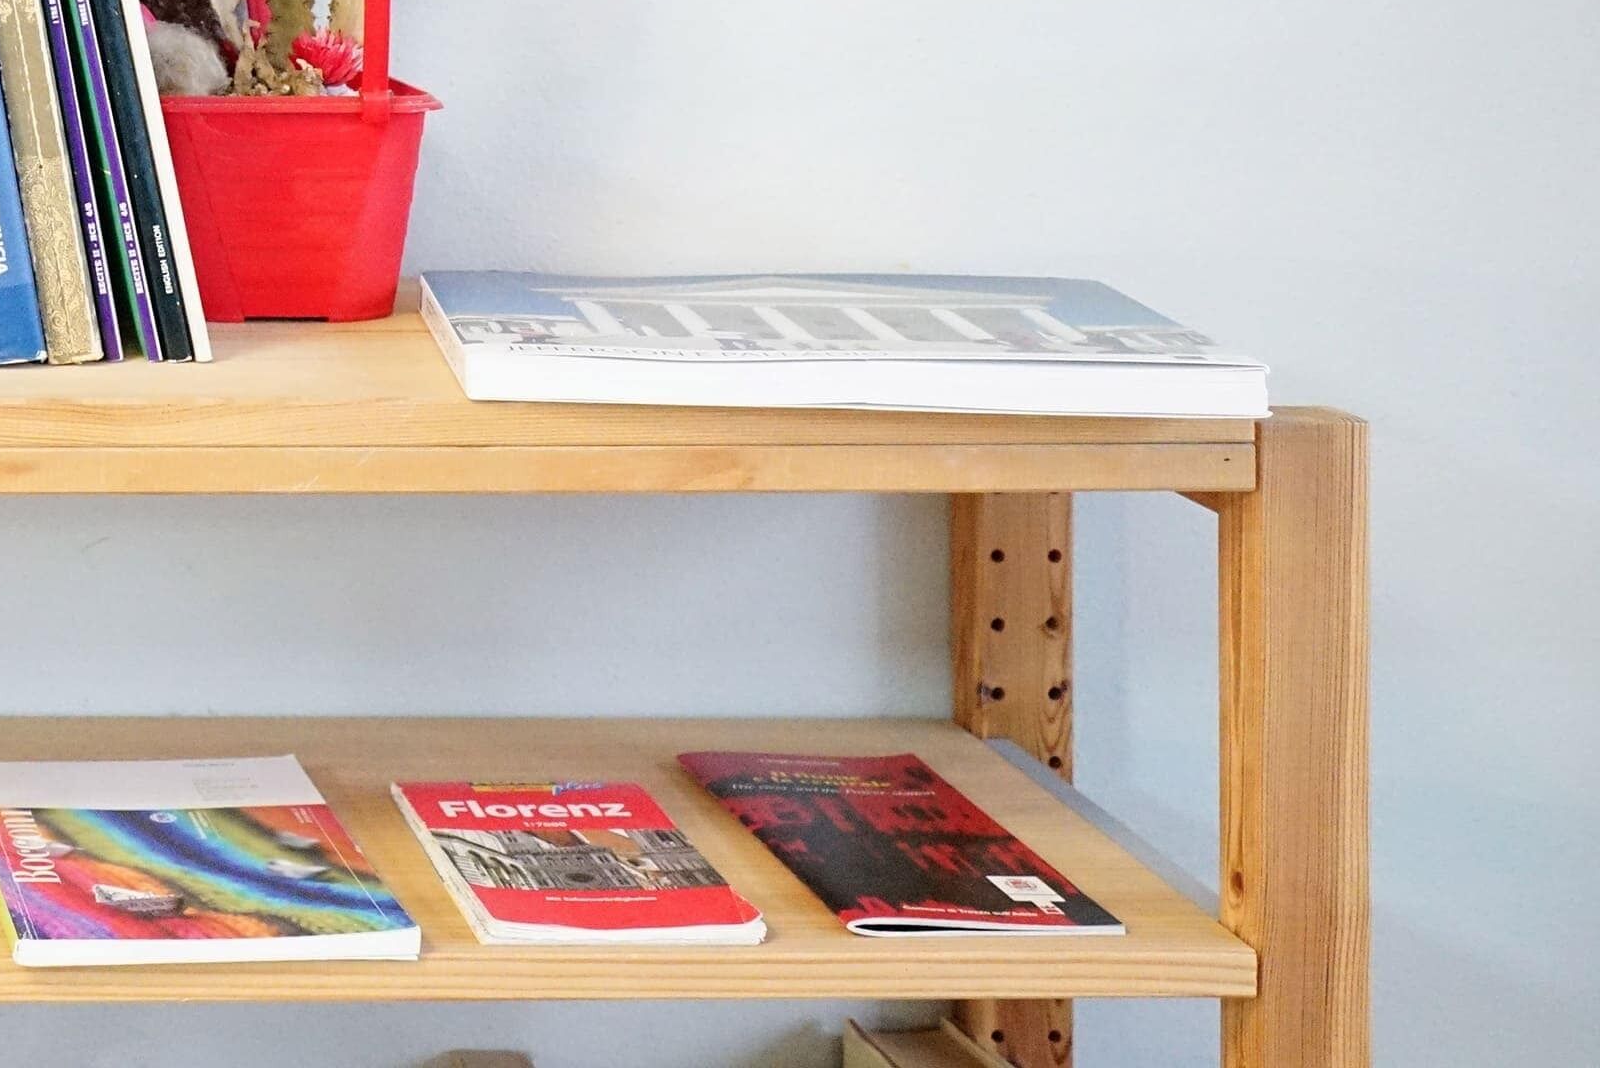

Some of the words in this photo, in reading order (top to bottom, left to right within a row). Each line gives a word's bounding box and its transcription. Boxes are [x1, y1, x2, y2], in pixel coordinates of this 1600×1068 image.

[151, 223, 167, 256] EDITION
[158, 258, 174, 293] ENGLISH
[438, 799, 633, 820] Florenz
